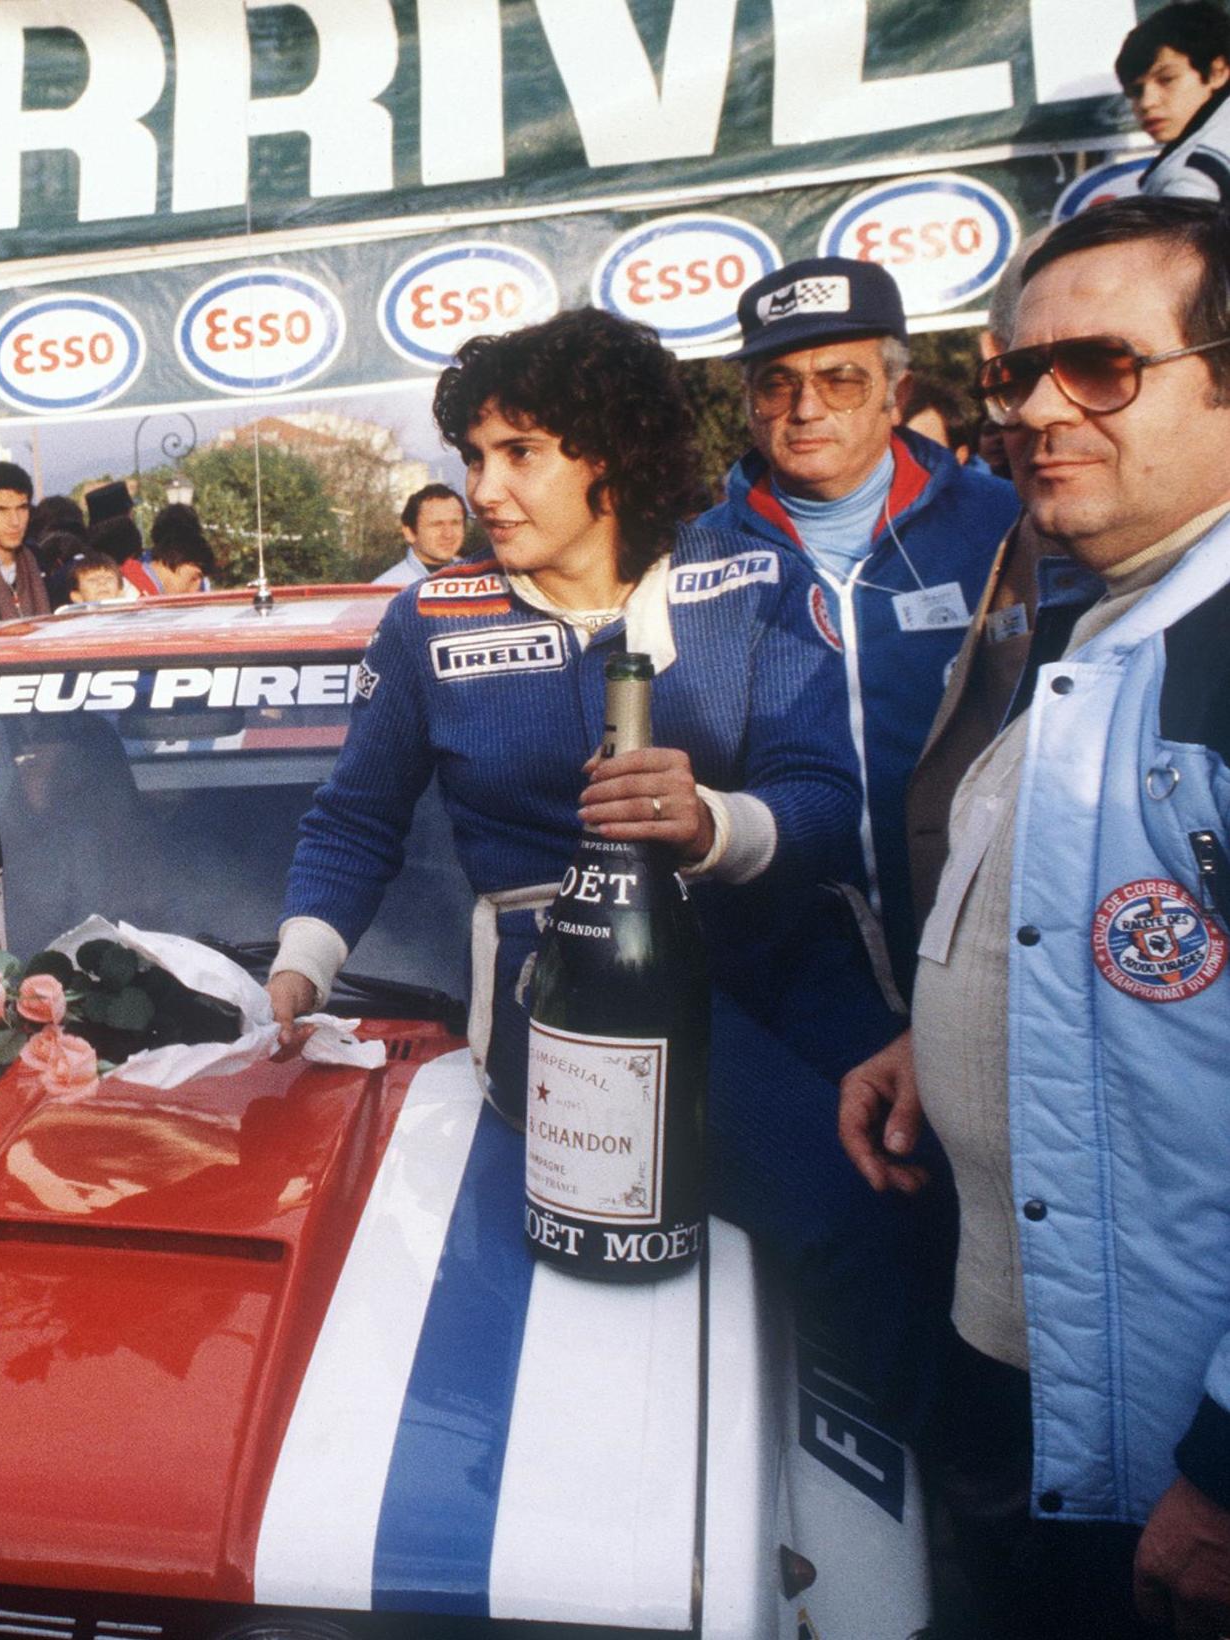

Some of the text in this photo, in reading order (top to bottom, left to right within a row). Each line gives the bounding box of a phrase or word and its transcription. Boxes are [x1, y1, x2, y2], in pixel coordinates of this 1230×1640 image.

[430, 576, 501, 595] TOTAL
[678, 556, 772, 593] FIAT
[437, 634, 555, 672] PIRELLI
[1104, 895, 1123, 913] DE
[1122, 881, 1178, 899] CORSE
[557, 920, 611, 939] CHANDON
[1102, 939, 1225, 1001] CHAMPIONNAT DU MONDE
[538, 1120, 633, 1155] CHANDON
[603, 1221, 701, 1263] MOËT
